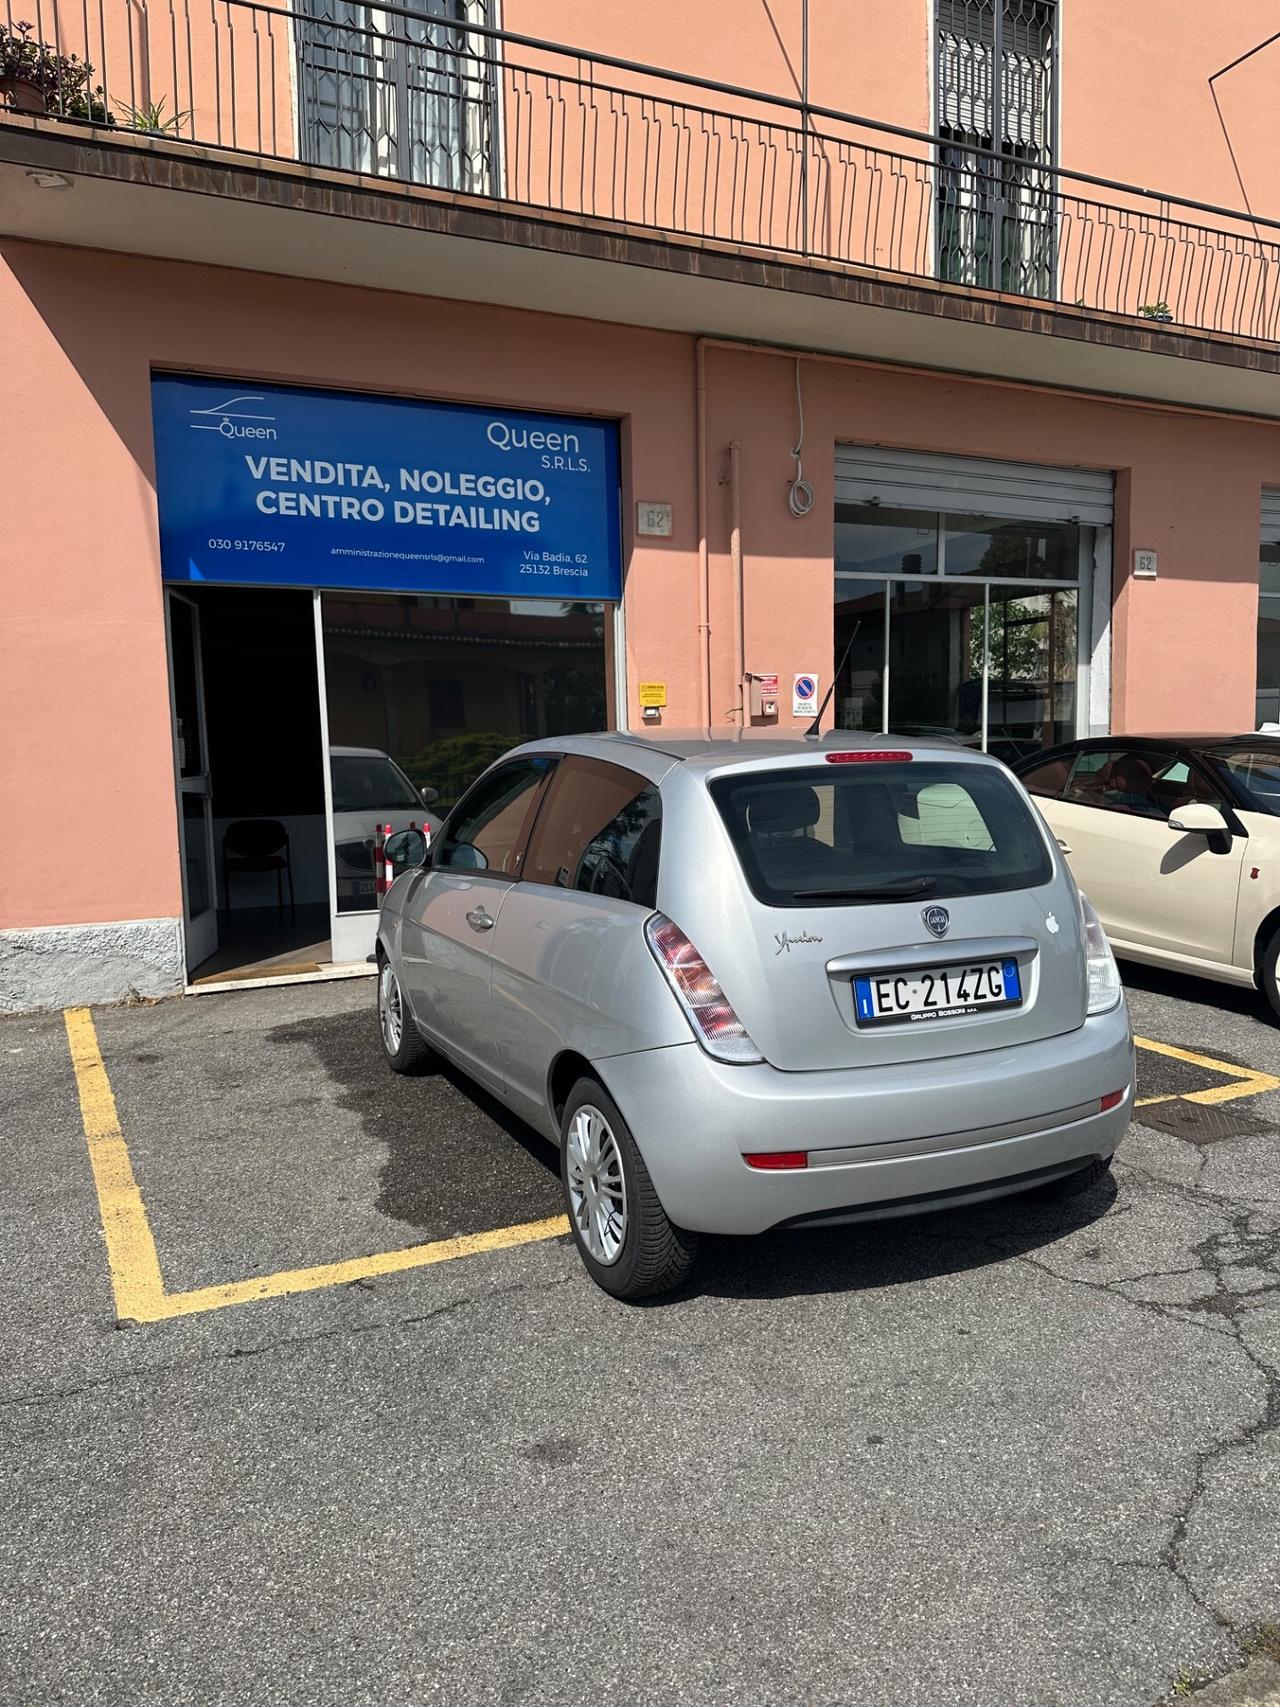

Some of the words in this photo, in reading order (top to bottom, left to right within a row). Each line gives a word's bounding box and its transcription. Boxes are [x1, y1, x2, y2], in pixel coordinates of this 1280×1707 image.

[219, 421, 277, 440] Queen
[487, 422, 580, 453] Queen
[541, 455, 591, 472] S.R.L.S.
[245, 455, 391, 493] VENDITA,
[400, 468, 550, 506] NOLEGGIO,
[256, 490, 385, 522] CENTRO
[394, 501, 540, 533] DETAILING
[647, 510, 665, 528] 62
[208, 538, 231, 550] 030
[234, 540, 285, 553] 9176547
[330, 547, 485, 564] amministrazionequeensrls@gmail.com
[523, 550, 540, 561] Via
[542, 551, 573, 565] Badia,
[575, 554, 588, 565] 62
[1139, 556, 1152, 570] 62
[519, 563, 551, 575] 25132
[553, 566, 589, 577] Brescia
[911, 1011, 937, 1021] GRUPPO
[938, 1007, 966, 1017] BOSSONI
